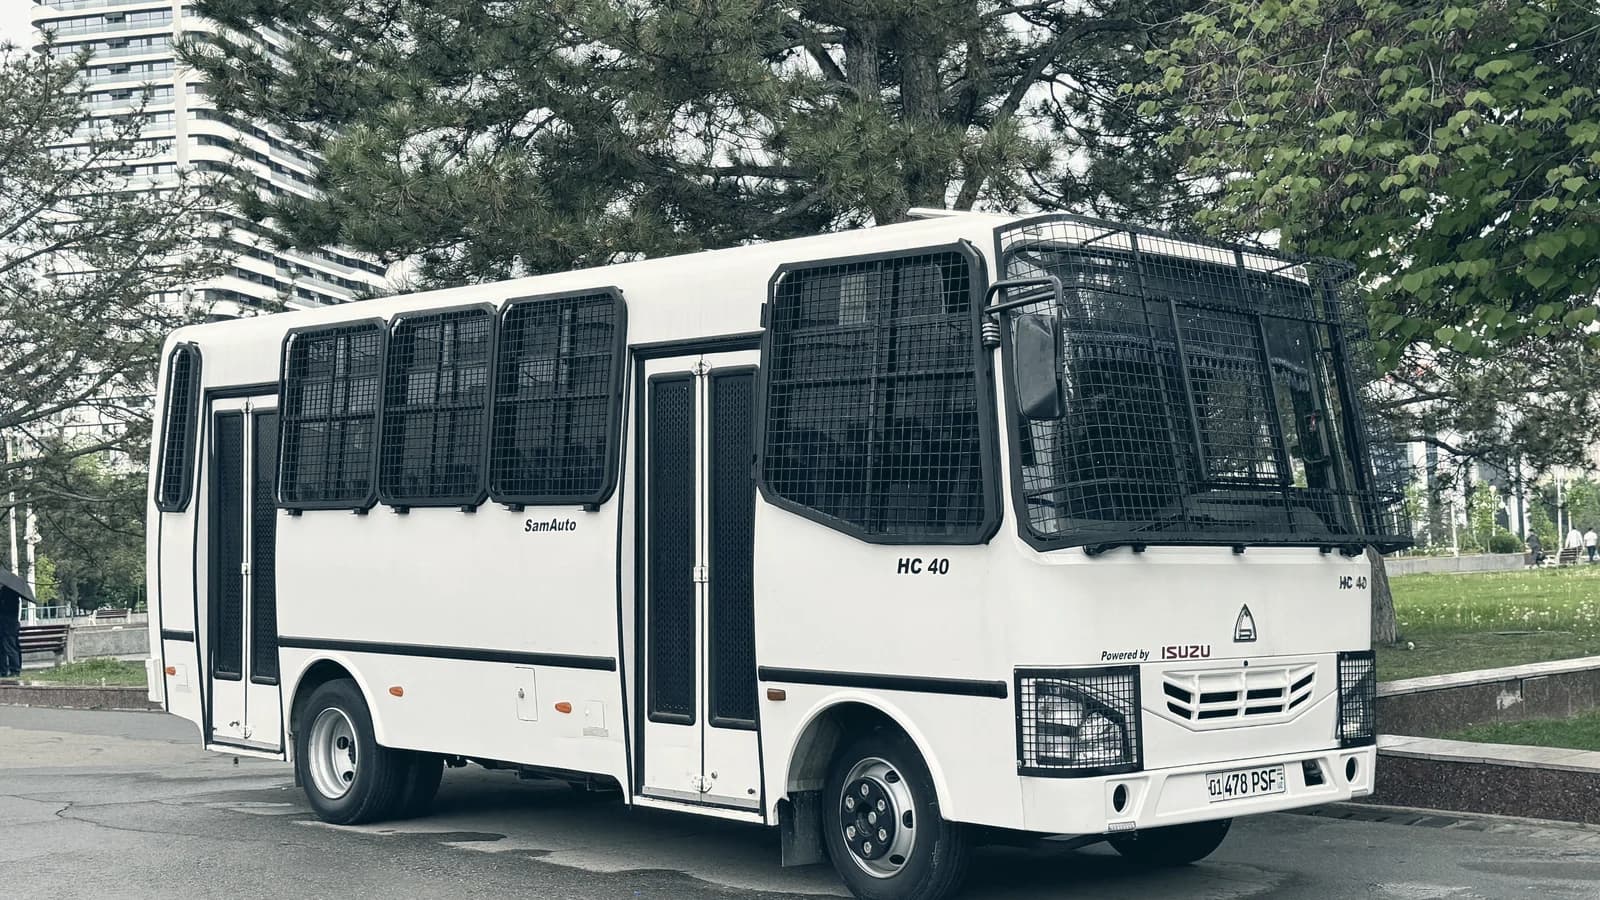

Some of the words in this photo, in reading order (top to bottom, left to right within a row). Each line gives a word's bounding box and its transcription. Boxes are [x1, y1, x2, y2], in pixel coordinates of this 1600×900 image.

[524, 518, 577, 532] SamAuto
[897, 558, 922, 574] HC
[927, 558, 949, 575] 40
[1339, 575, 1353, 590] HC
[1355, 575, 1367, 590] 40
[1101, 649, 1138, 661] Powered
[1139, 649, 1150, 661] by
[1161, 645, 1210, 660] ISUZU
[1209, 778, 1222, 796] 01
[1224, 773, 1248, 796] 478
[1251, 768, 1276, 793] PSF
